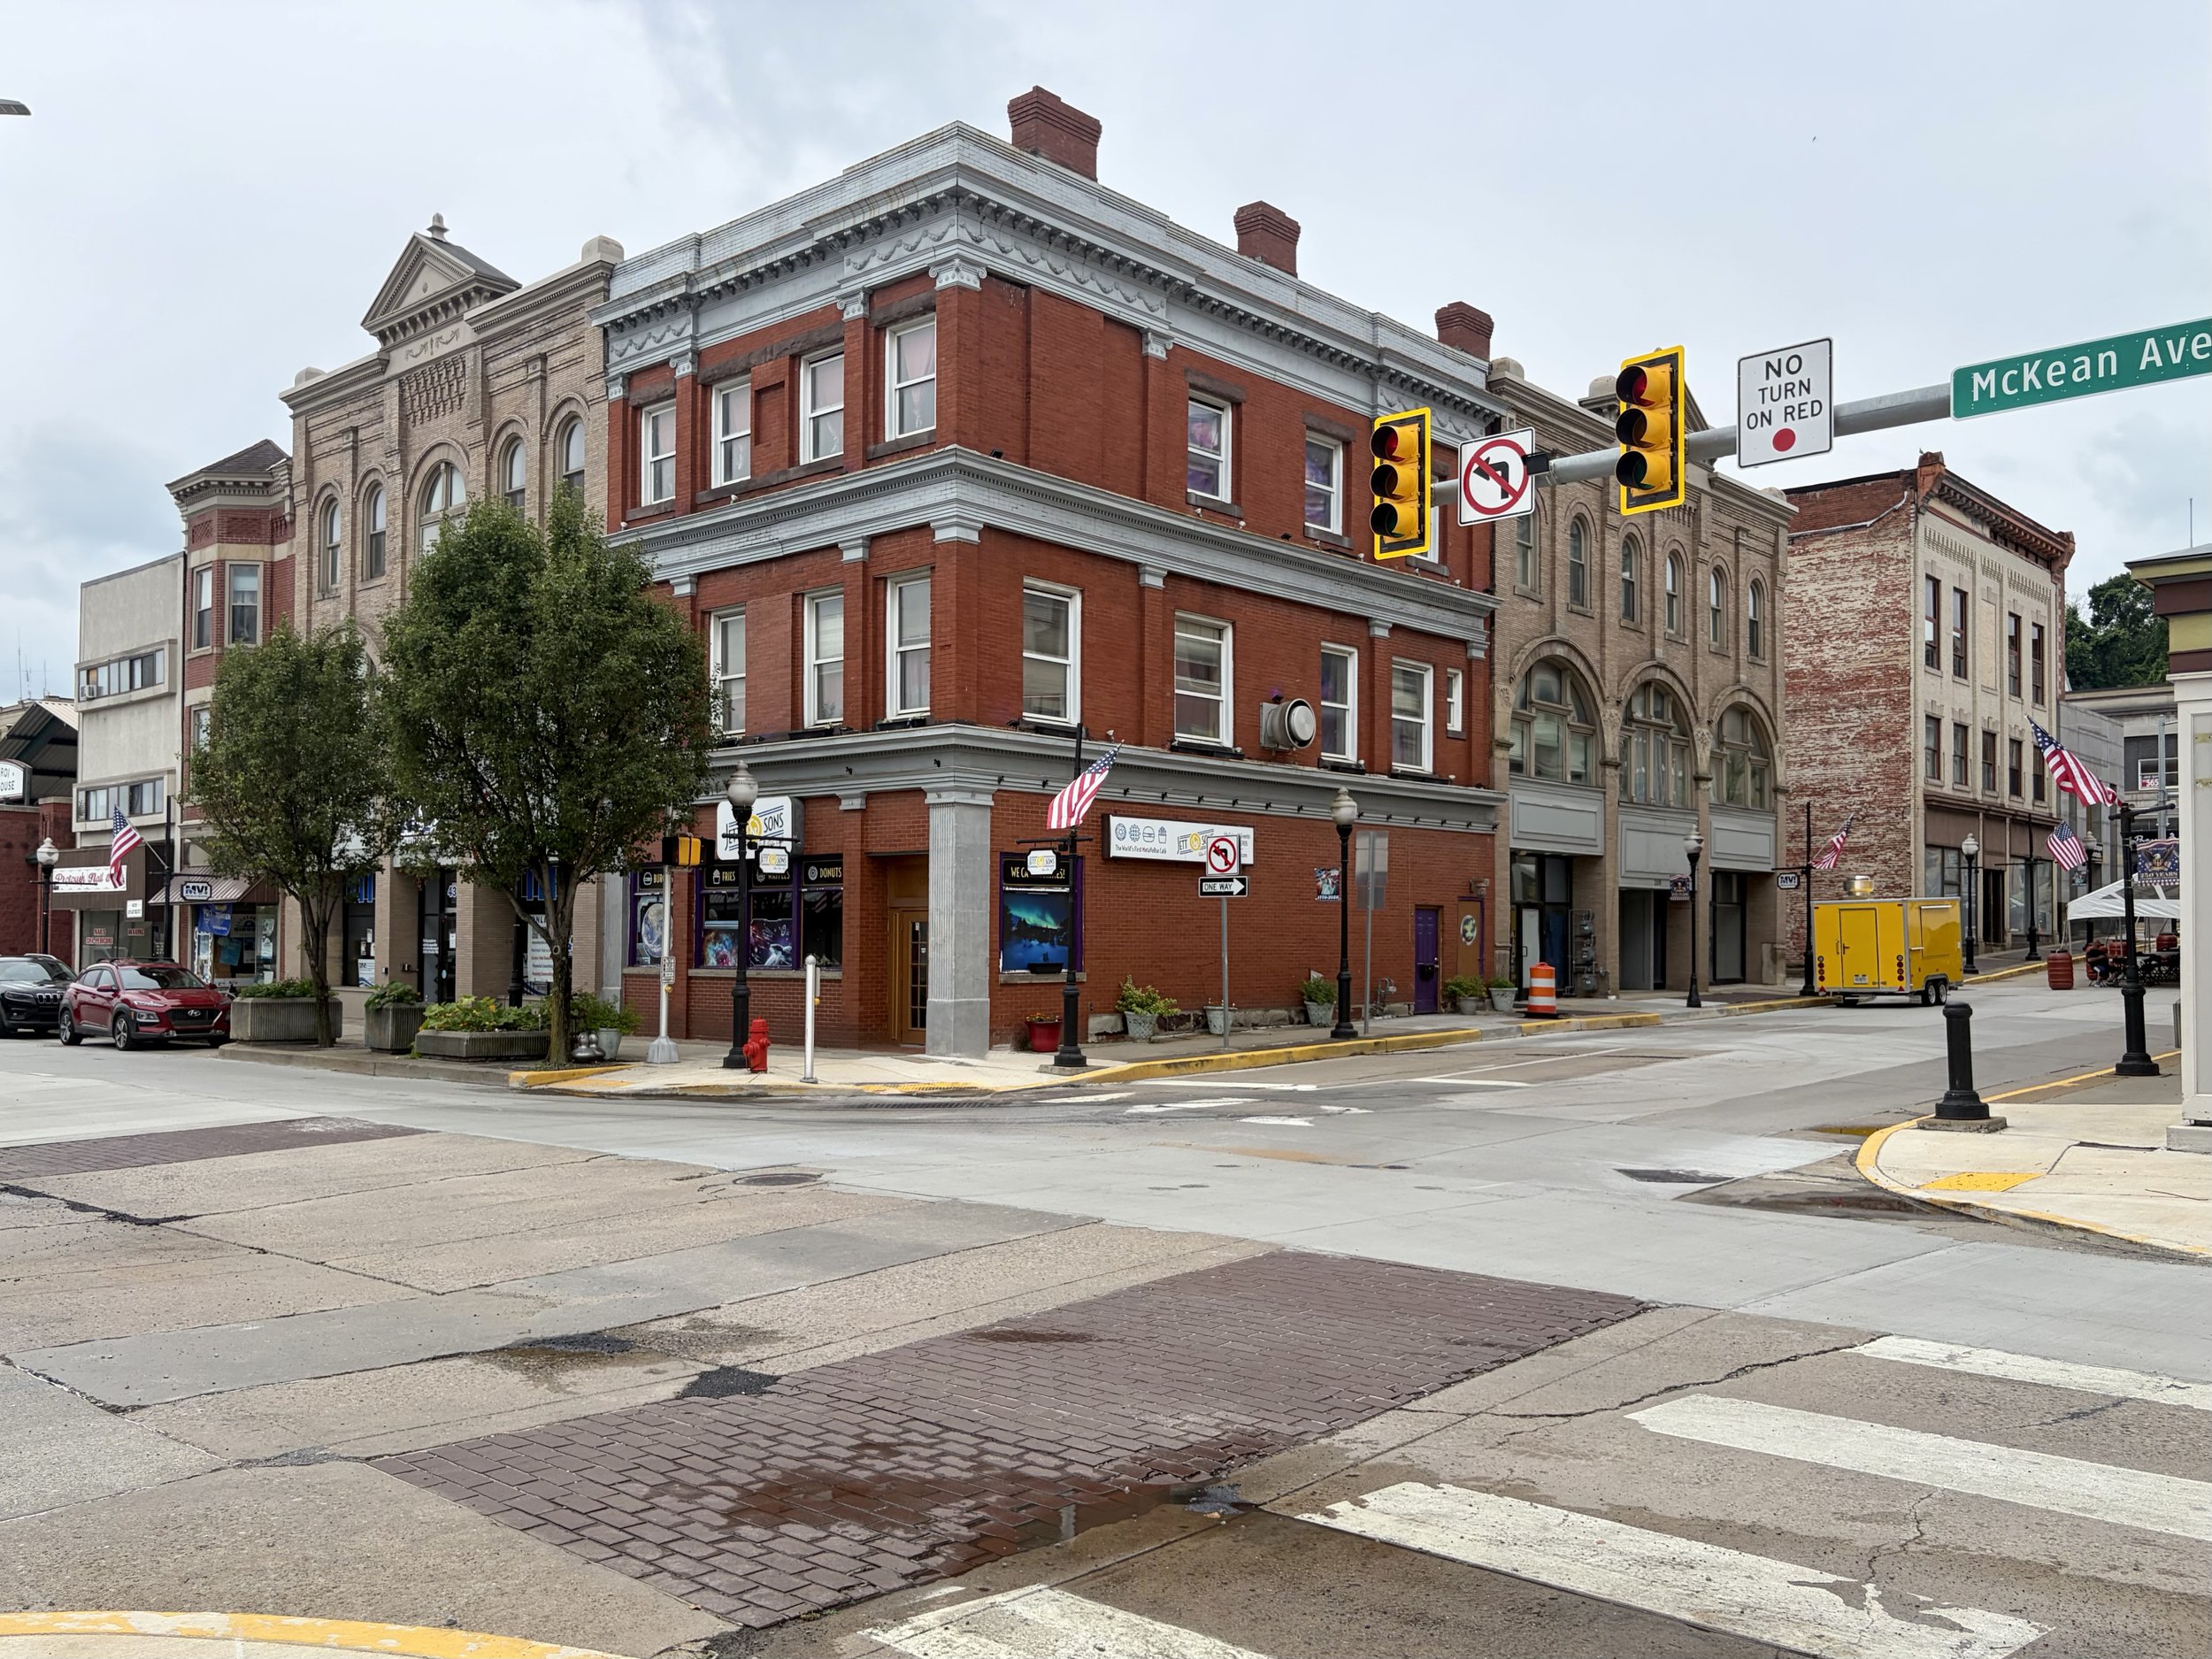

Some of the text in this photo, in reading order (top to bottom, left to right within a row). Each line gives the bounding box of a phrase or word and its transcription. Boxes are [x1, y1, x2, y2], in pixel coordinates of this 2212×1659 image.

[1765, 354, 1802, 380] NO
[1972, 331, 2212, 402] McKean Ave
[1758, 378, 1810, 404] TURN
[1747, 399, 1823, 430] ON RED
[764, 812, 784, 833] SONS
[1177, 836, 1187, 854] JETT
[722, 872, 735, 881] FRIES
[819, 867, 842, 878] DONUTS
[1010, 867, 1020, 878] WE
